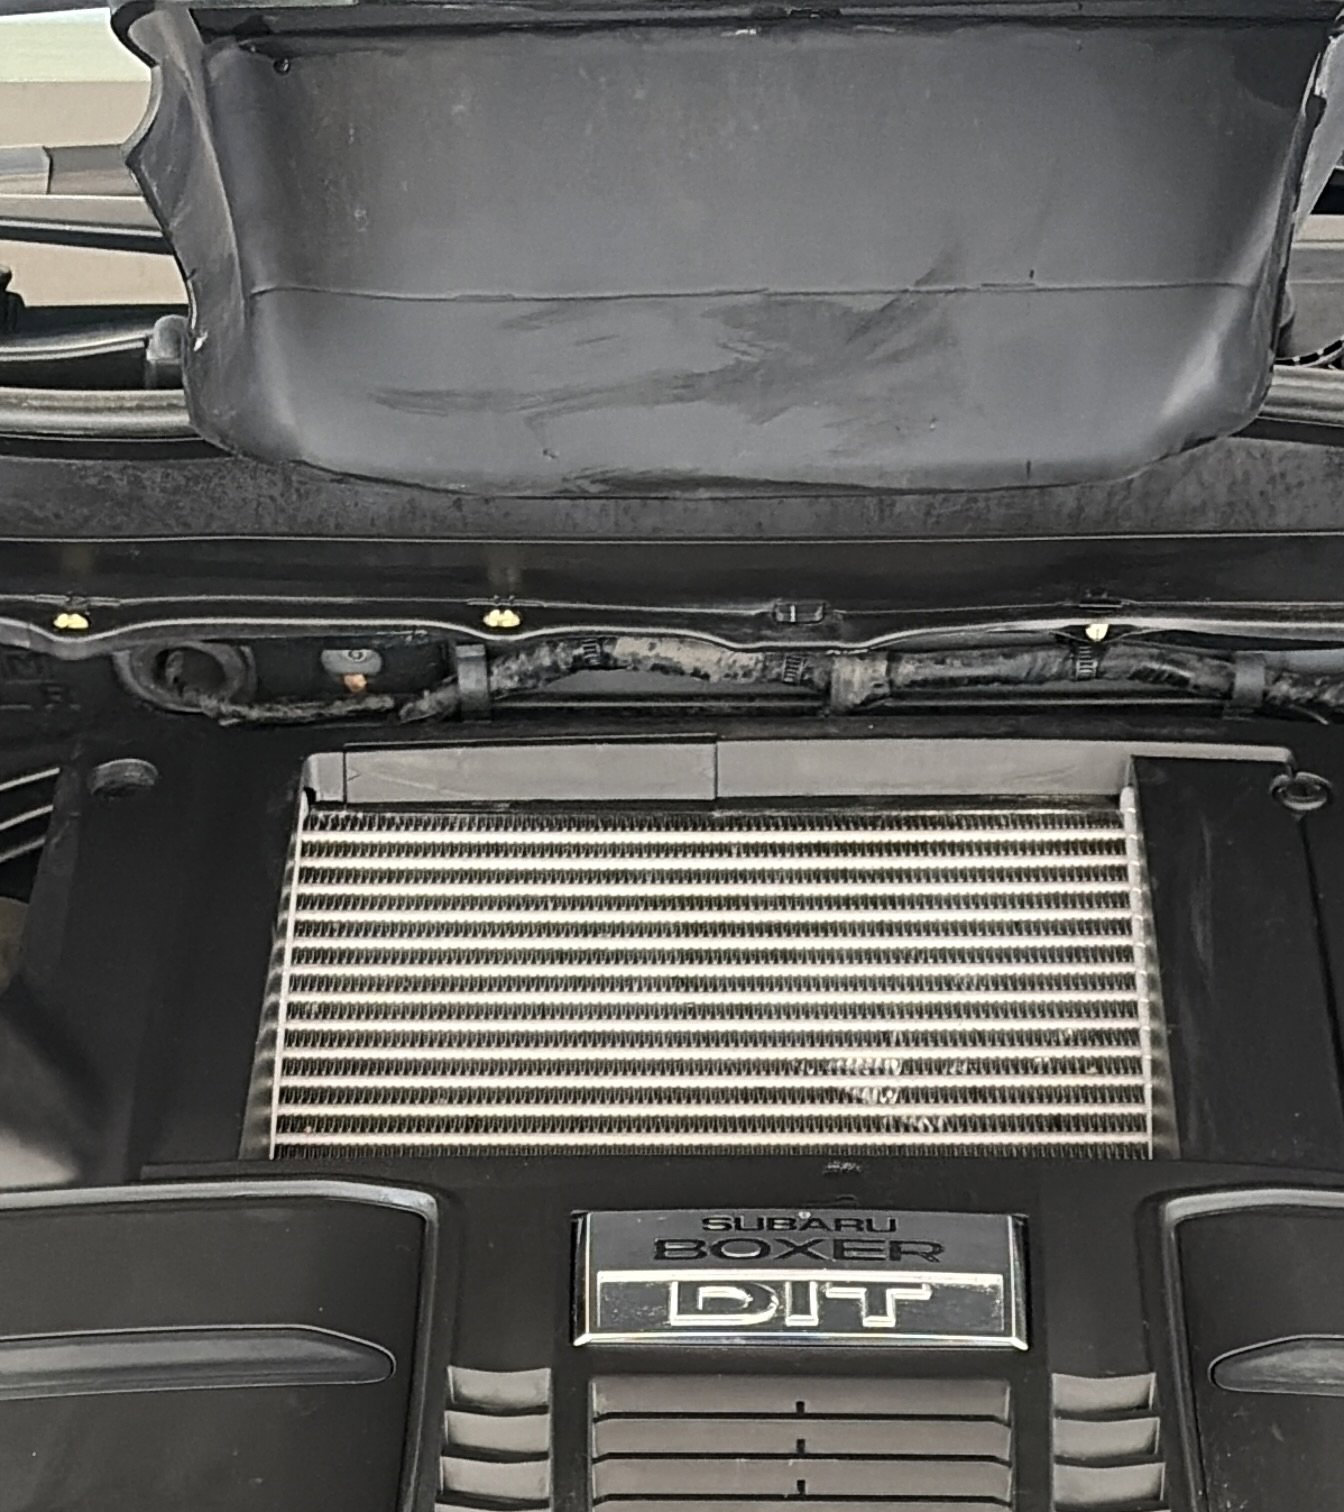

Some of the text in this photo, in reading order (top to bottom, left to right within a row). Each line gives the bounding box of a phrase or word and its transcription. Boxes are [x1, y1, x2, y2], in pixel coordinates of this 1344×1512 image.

[701, 1214, 897, 1234] SUBARU
[653, 1237, 946, 1263] BOXER
[669, 1280, 932, 1328] DIT
